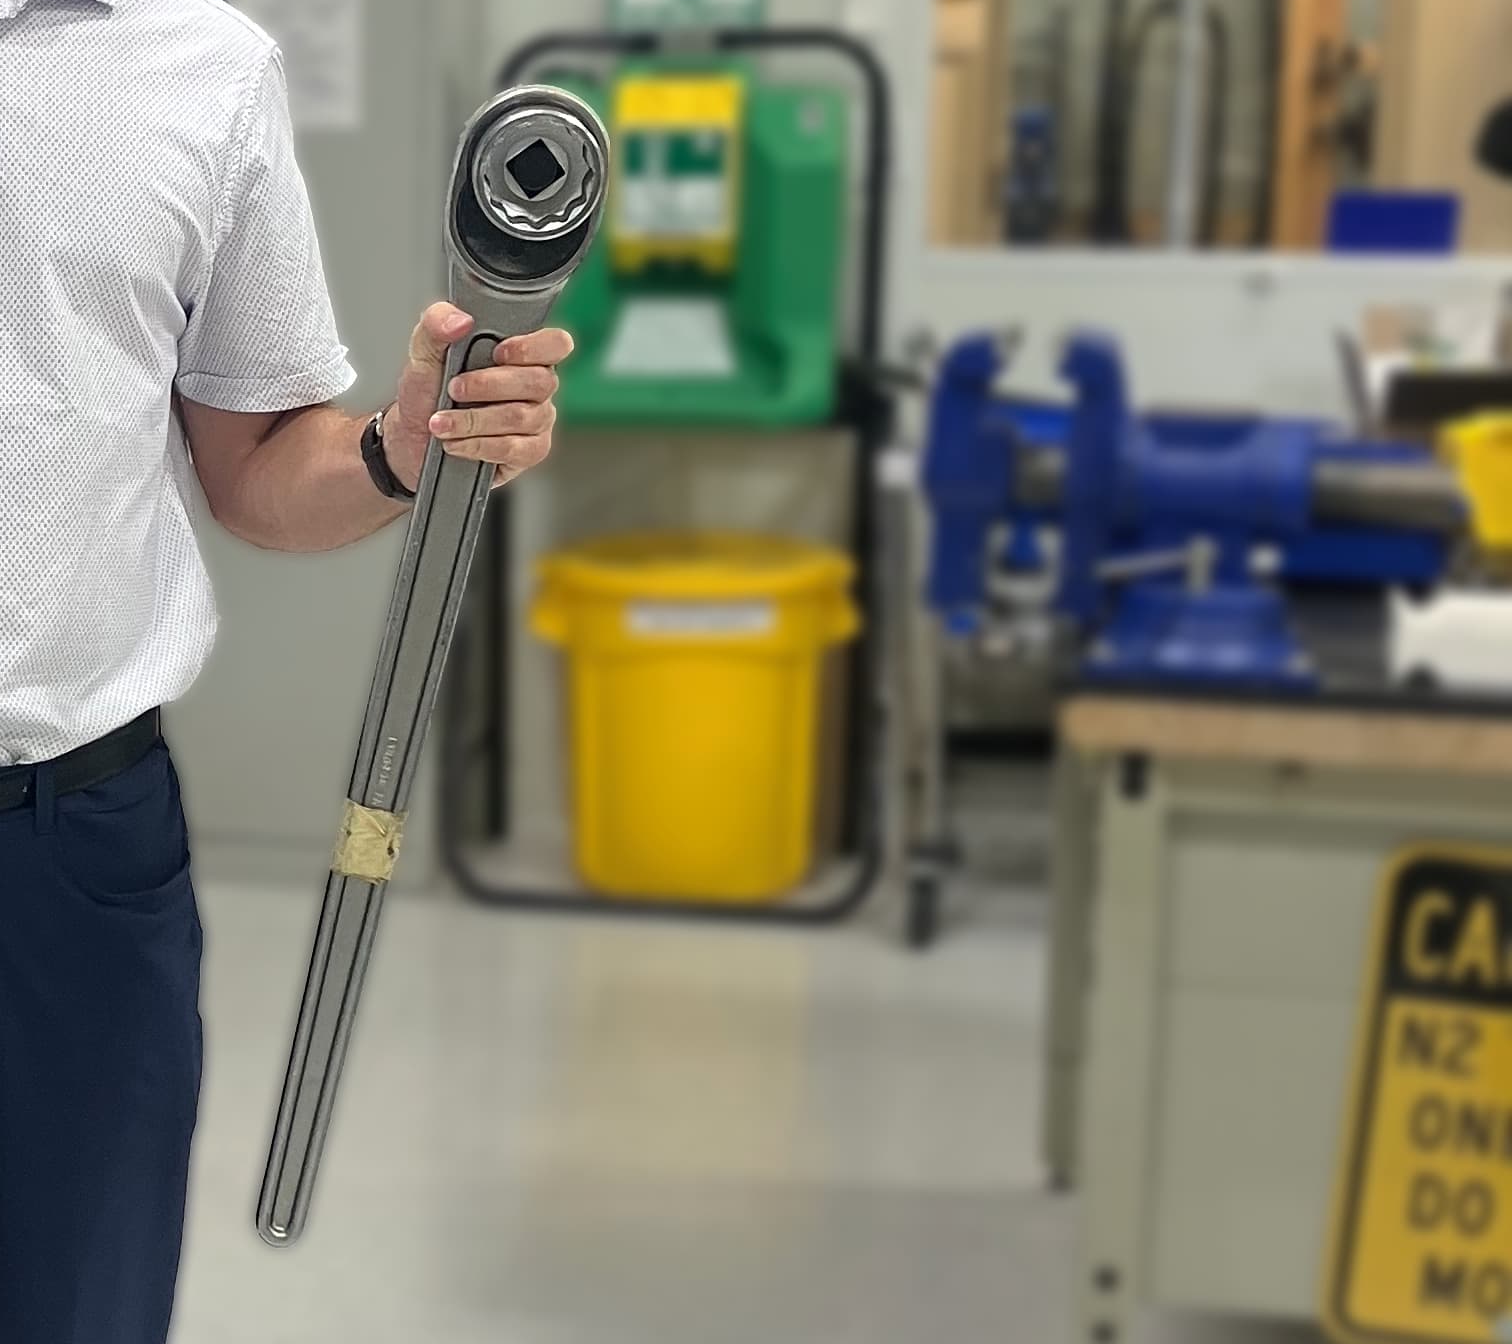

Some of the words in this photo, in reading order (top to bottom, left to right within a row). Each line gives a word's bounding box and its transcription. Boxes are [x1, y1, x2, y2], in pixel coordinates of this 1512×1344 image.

[1402, 889, 1512, 985] CA
[1399, 1015, 1483, 1078] N2
[1406, 1172, 1497, 1240] DO
